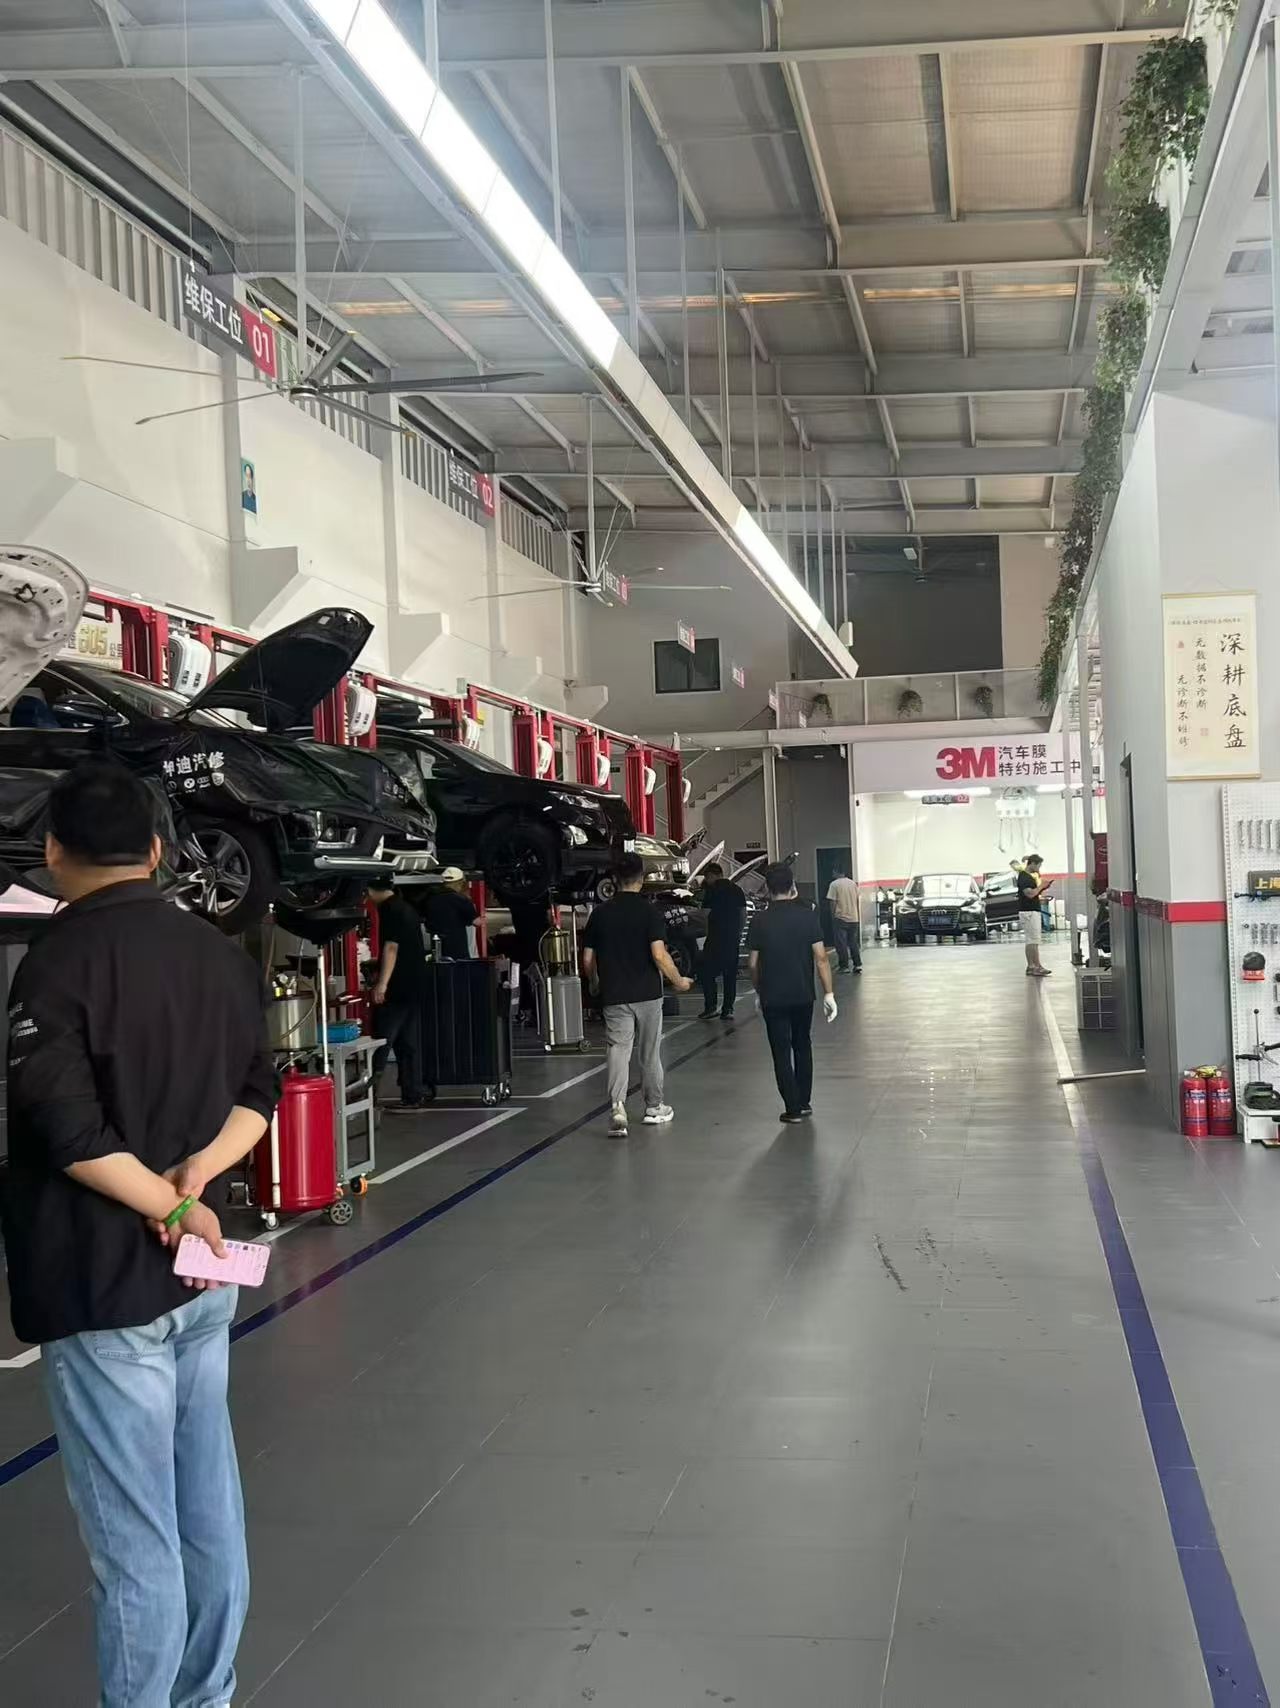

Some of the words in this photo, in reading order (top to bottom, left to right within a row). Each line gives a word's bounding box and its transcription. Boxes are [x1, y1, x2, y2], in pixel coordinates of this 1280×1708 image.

[184, 273, 244, 345] 维保工位
[252, 325, 270, 364] 01
[482, 483, 494, 509] 02
[1220, 632, 1248, 749] 深耕底盘
[935, 746, 996, 781] 3M
[998, 744, 1048, 761] 汽车膜
